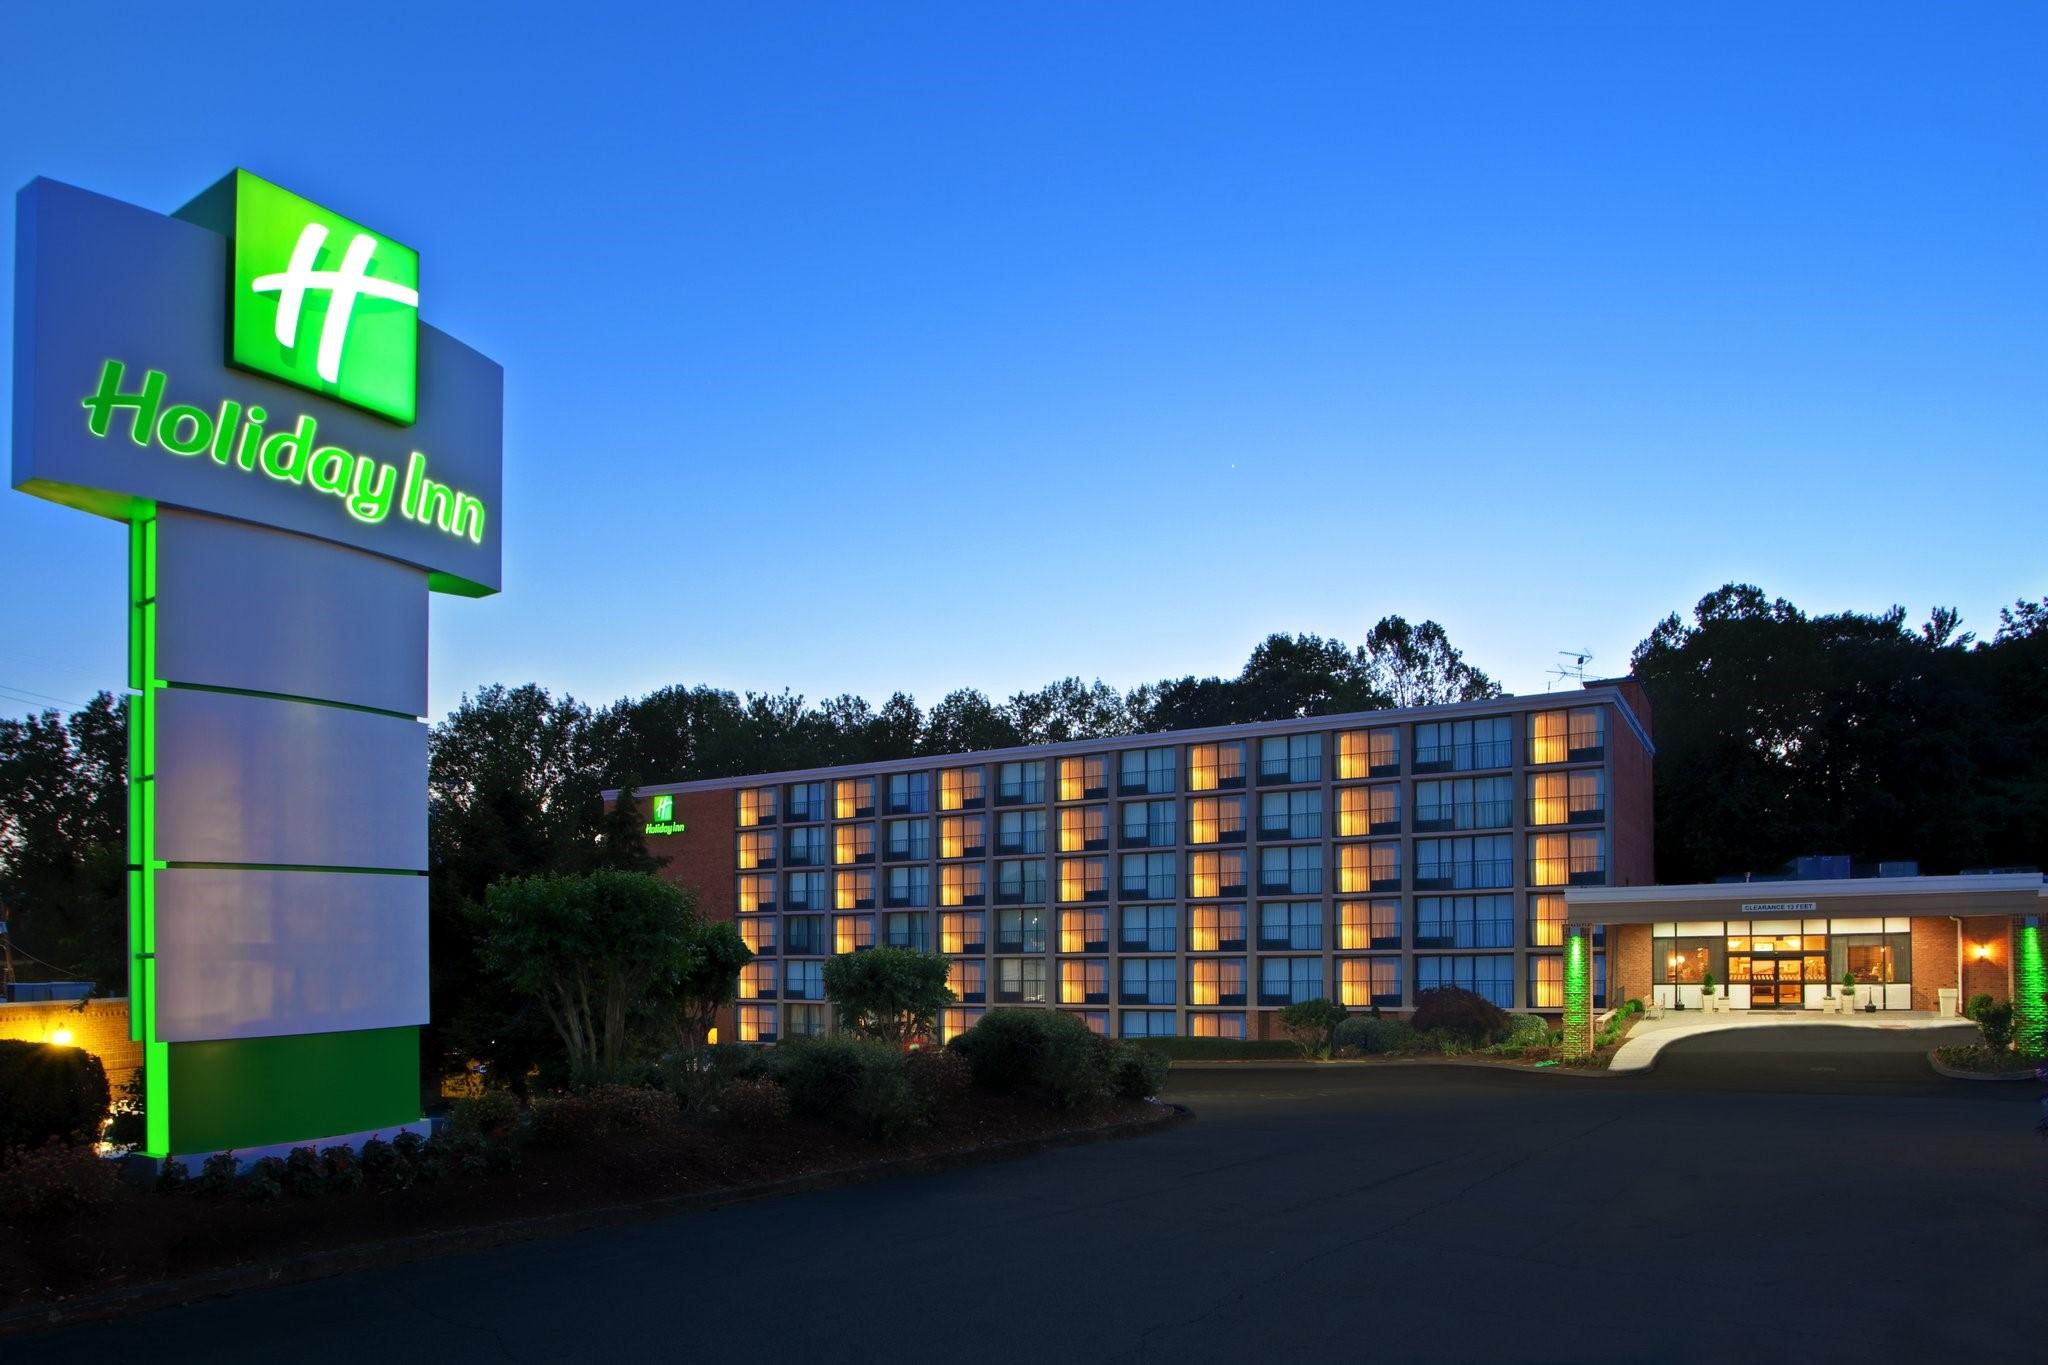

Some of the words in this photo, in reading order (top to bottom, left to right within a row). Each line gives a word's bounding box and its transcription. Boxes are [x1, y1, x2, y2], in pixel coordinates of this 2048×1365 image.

[252, 222, 418, 384] H
[83, 359, 397, 522] Holiday
[401, 451, 485, 543] Inn
[645, 823, 672, 835] Holiday
[672, 821, 685, 832] Inn
